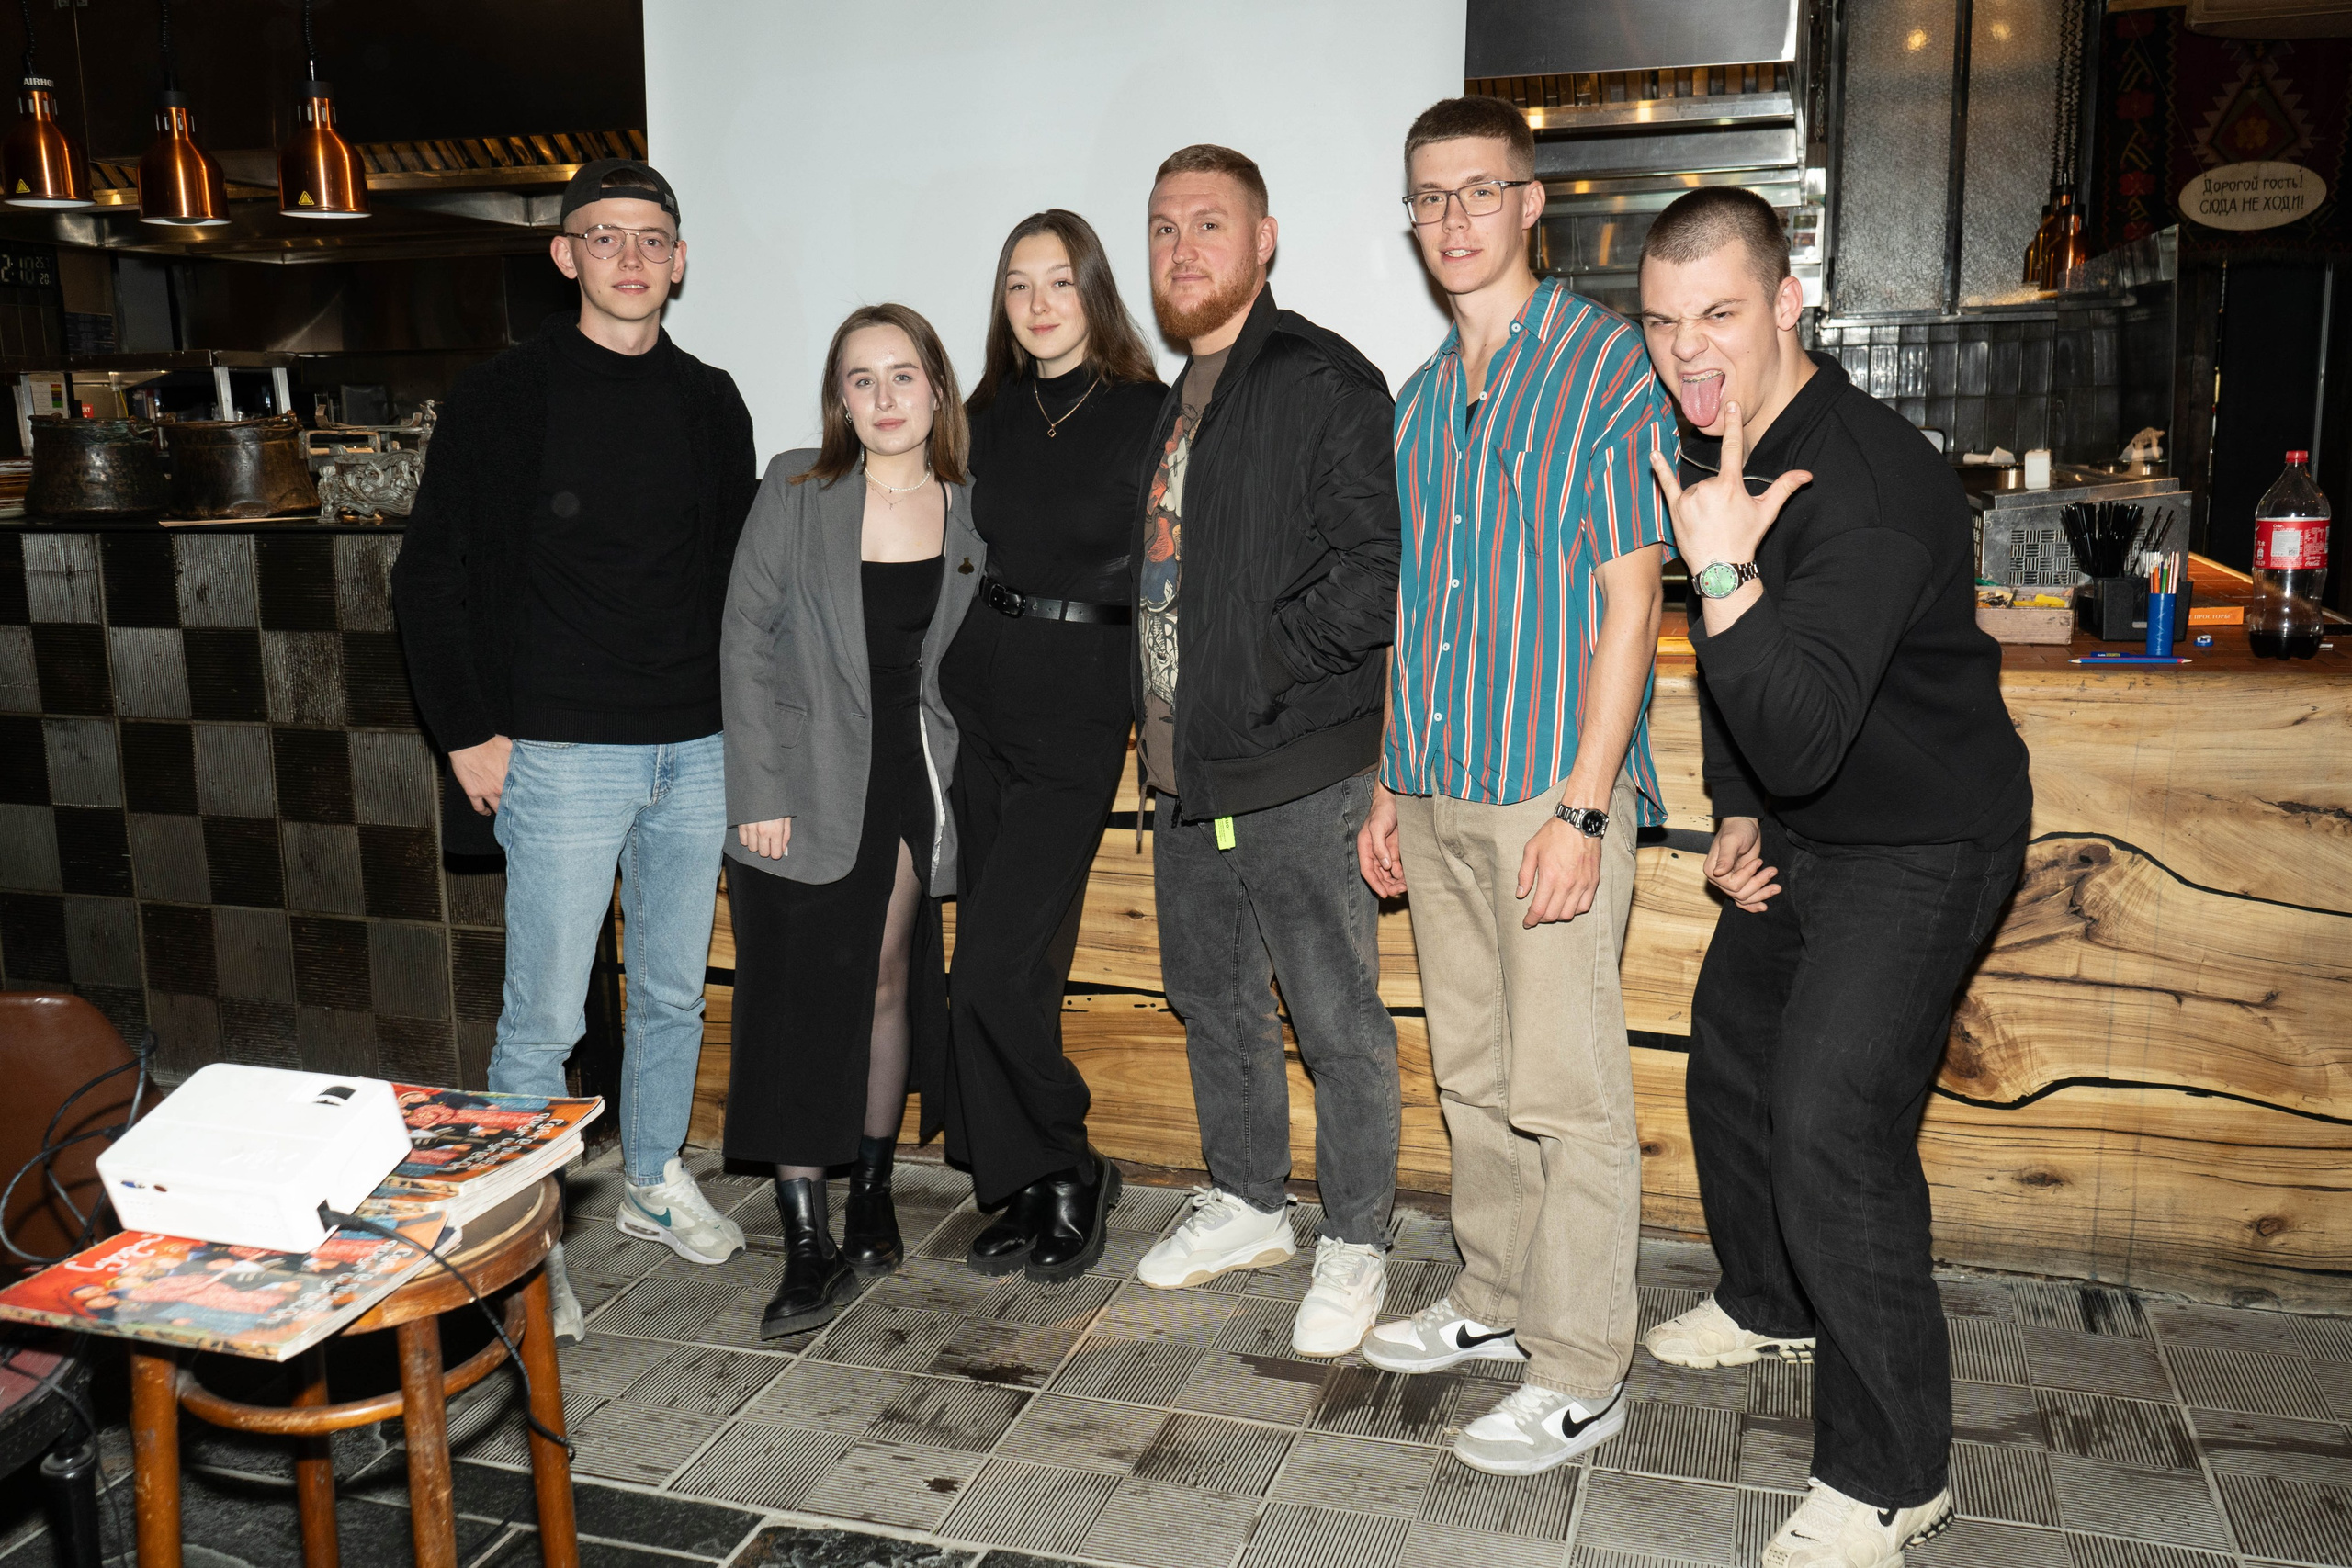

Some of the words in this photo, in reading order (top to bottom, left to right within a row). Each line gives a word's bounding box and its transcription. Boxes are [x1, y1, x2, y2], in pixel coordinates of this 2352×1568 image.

[2202, 175, 2259, 196] Дорогой
[2263, 173, 2304, 191] гость!
[2199, 198, 2238, 217] СЮДА
[2242, 197, 2259, 212] НЕ
[2262, 194, 2305, 213] ХОДИ!
